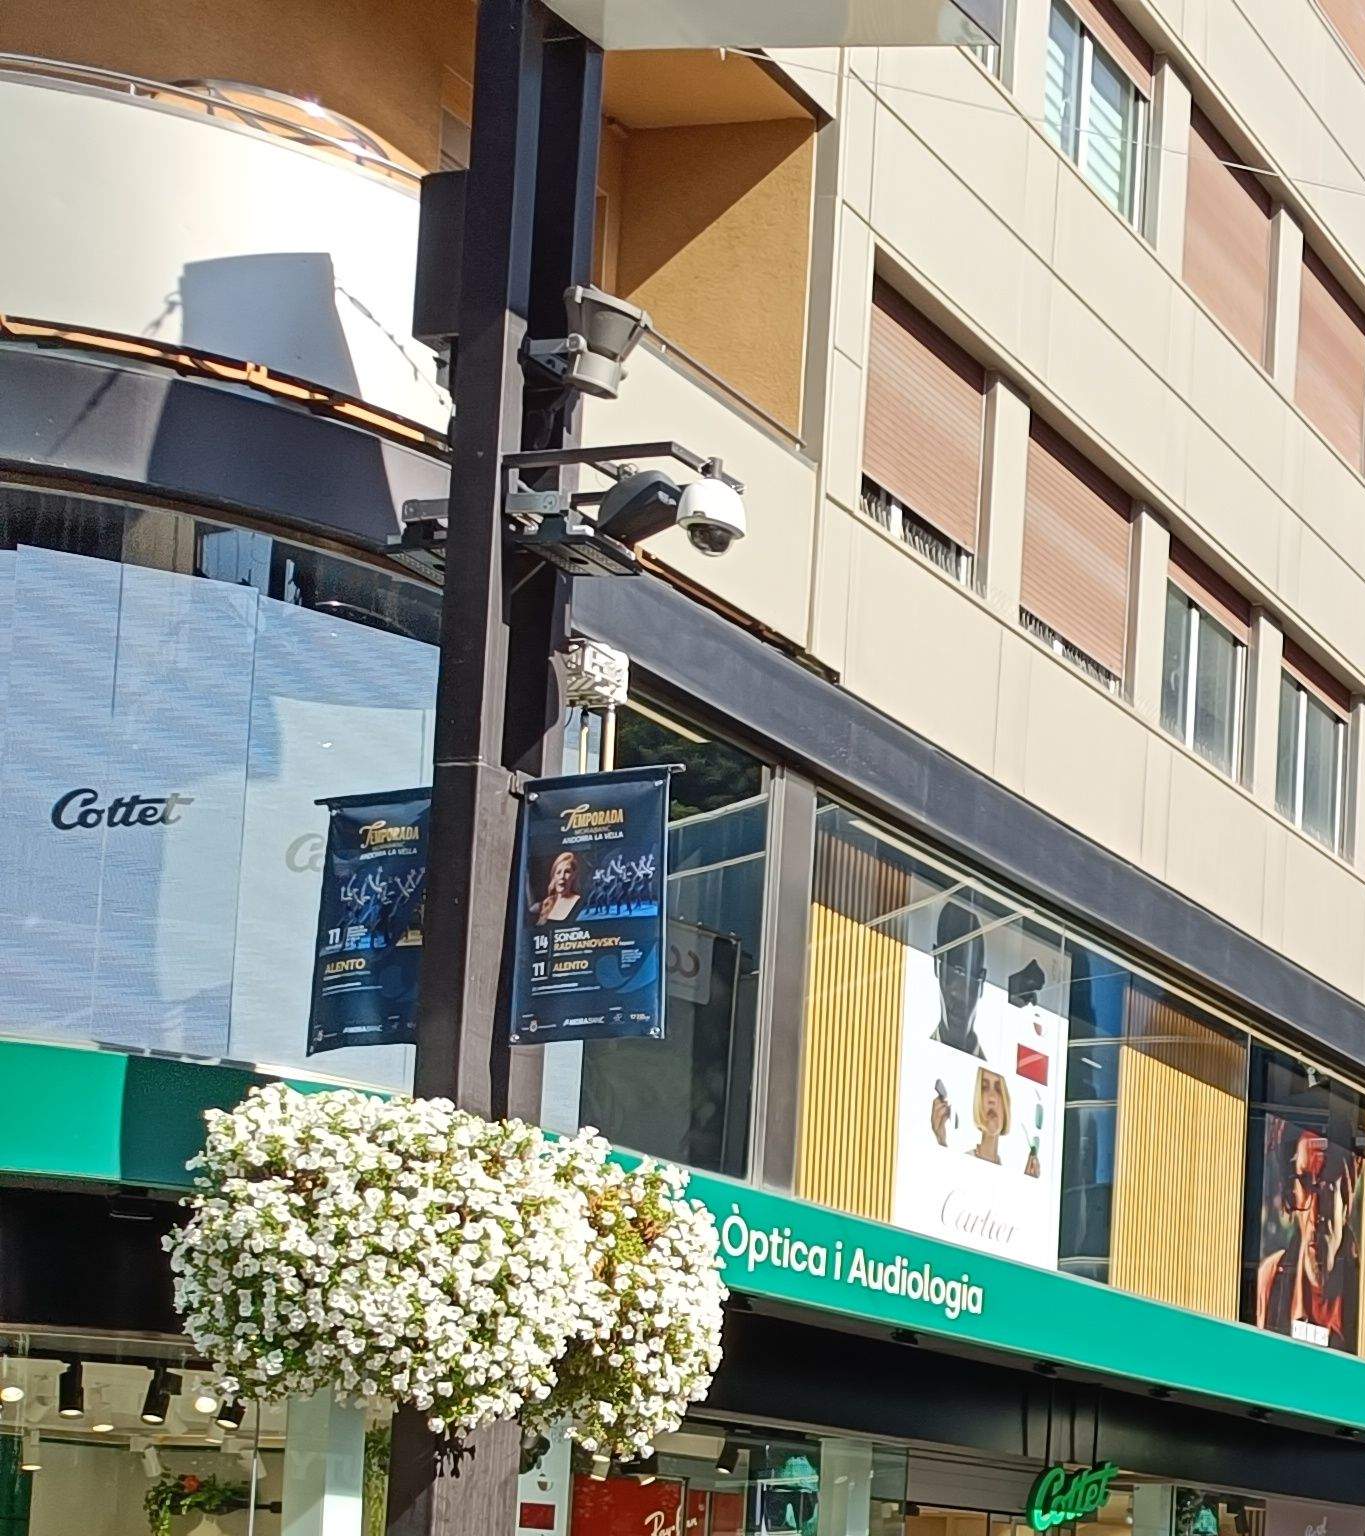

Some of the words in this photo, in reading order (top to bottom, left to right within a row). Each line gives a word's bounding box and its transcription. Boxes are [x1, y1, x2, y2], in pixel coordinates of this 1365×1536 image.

[52, 788, 194, 830] Cottet
[560, 804, 625, 832] TEMPORADA
[359, 820, 419, 849] TEMPORADA
[554, 931, 591, 943] SONDRA
[325, 958, 366, 975] ALENTO
[553, 960, 589, 972] ALENTO
[940, 1189, 1021, 1244] Cartier
[721, 1203, 828, 1277] Òptica
[833, 1241, 843, 1280] i
[847, 1248, 984, 1320] Audiologia
[1034, 1462, 1120, 1531] Cottet
